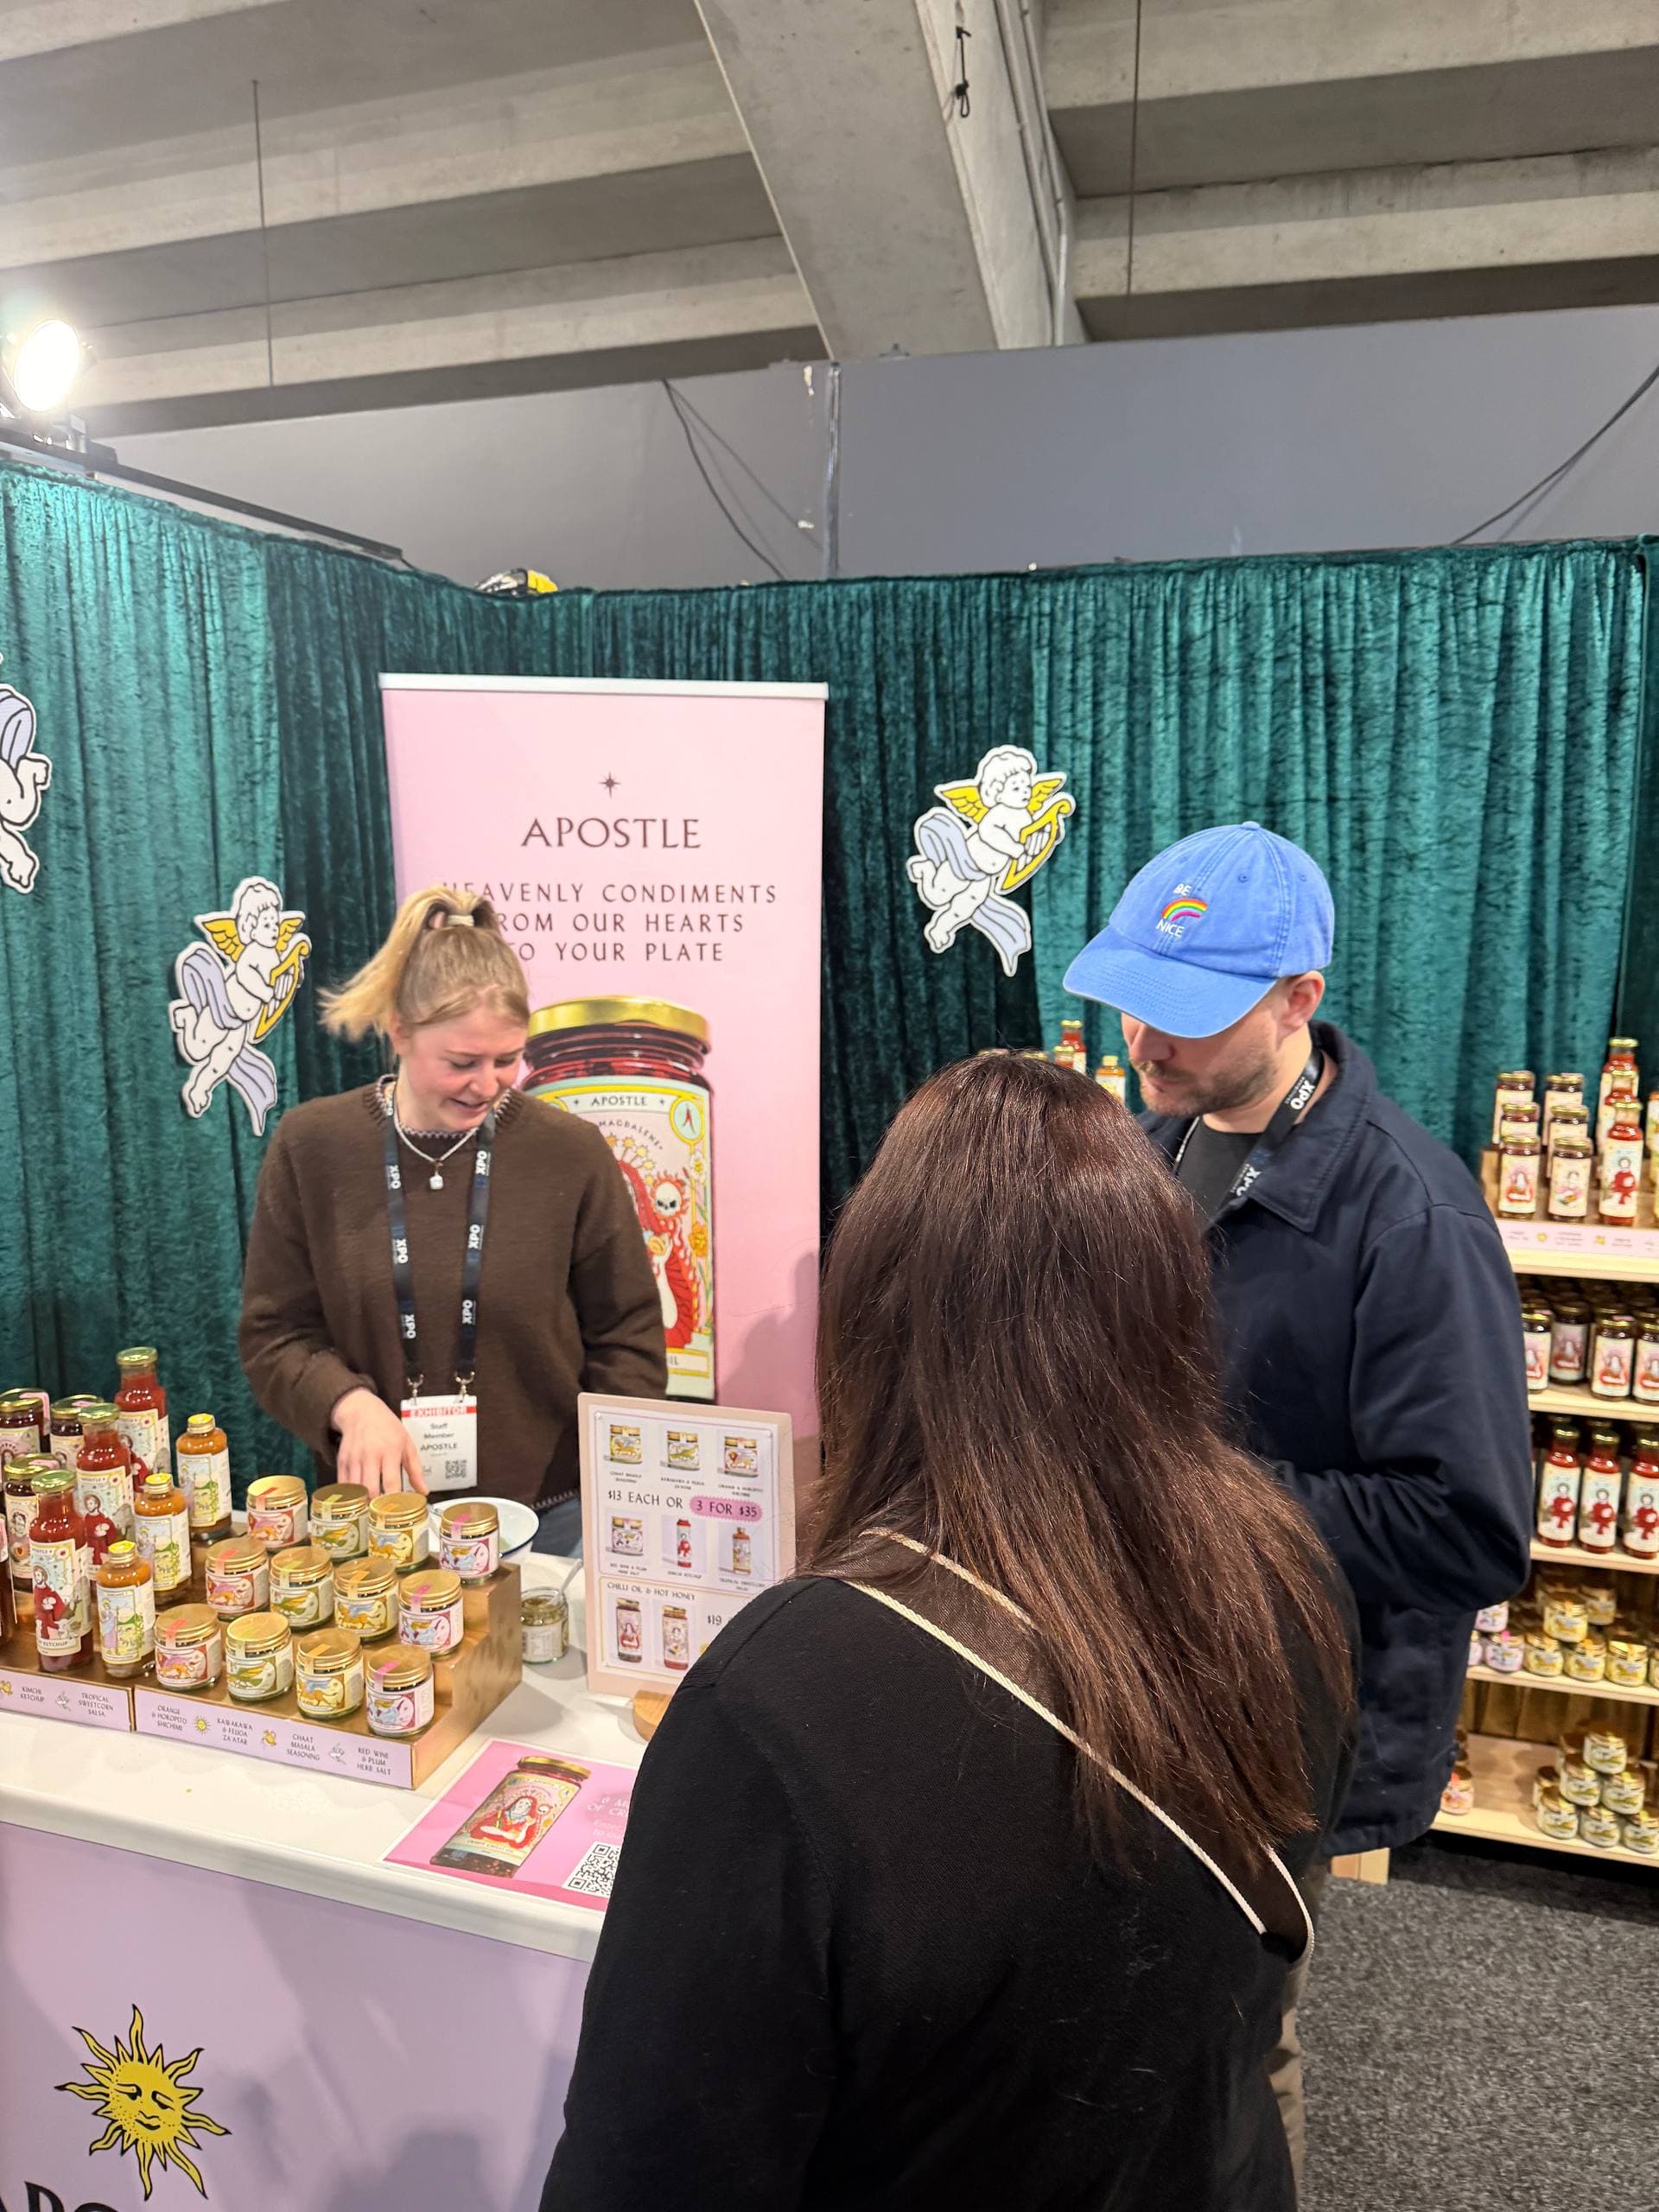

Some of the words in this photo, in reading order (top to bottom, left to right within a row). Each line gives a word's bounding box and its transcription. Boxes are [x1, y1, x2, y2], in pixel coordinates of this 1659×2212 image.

[521, 817, 702, 849] APOSTLE
[602, 884, 776, 904] CONDIMENTS
[1173, 883, 1192, 895] BE
[498, 912, 554, 932] ROM
[573, 912, 626, 932] OUR
[645, 913, 744, 932] HEARTS
[1155, 919, 1185, 938] NICE
[556, 942, 626, 962] YOUR
[646, 943, 727, 962] PLATE
[592, 1096, 648, 1107] APOSTLE
[1290, 1079, 1315, 1110] XPO
[475, 1150, 487, 1175] XPO
[390, 1165, 402, 1190] XPO
[468, 1224, 481, 1249] XPO
[397, 1238, 409, 1264] XPO
[462, 1300, 474, 1324] XPO
[404, 1314, 416, 1339] XPO
[608, 1490, 622, 1501] $13
[628, 1491, 660, 1506] EACH
[666, 1496, 683, 1509] OR
[696, 1499, 702, 1511] 3
[710, 1502, 733, 1515] FOR
[740, 1506, 759, 1518] $35
[707, 1614, 723, 1626] $19
[81, 1692, 110, 1703] TROPICAL
[158, 1705, 181, 1715] ORANGE
[217, 1718, 254, 1731] KAWAKAWA
[291, 1741, 316, 1752] MASALA
[292, 1733, 314, 1744] CHAAT
[374, 1751, 390, 1759] WINE
[377, 1766, 392, 1776] SALT
